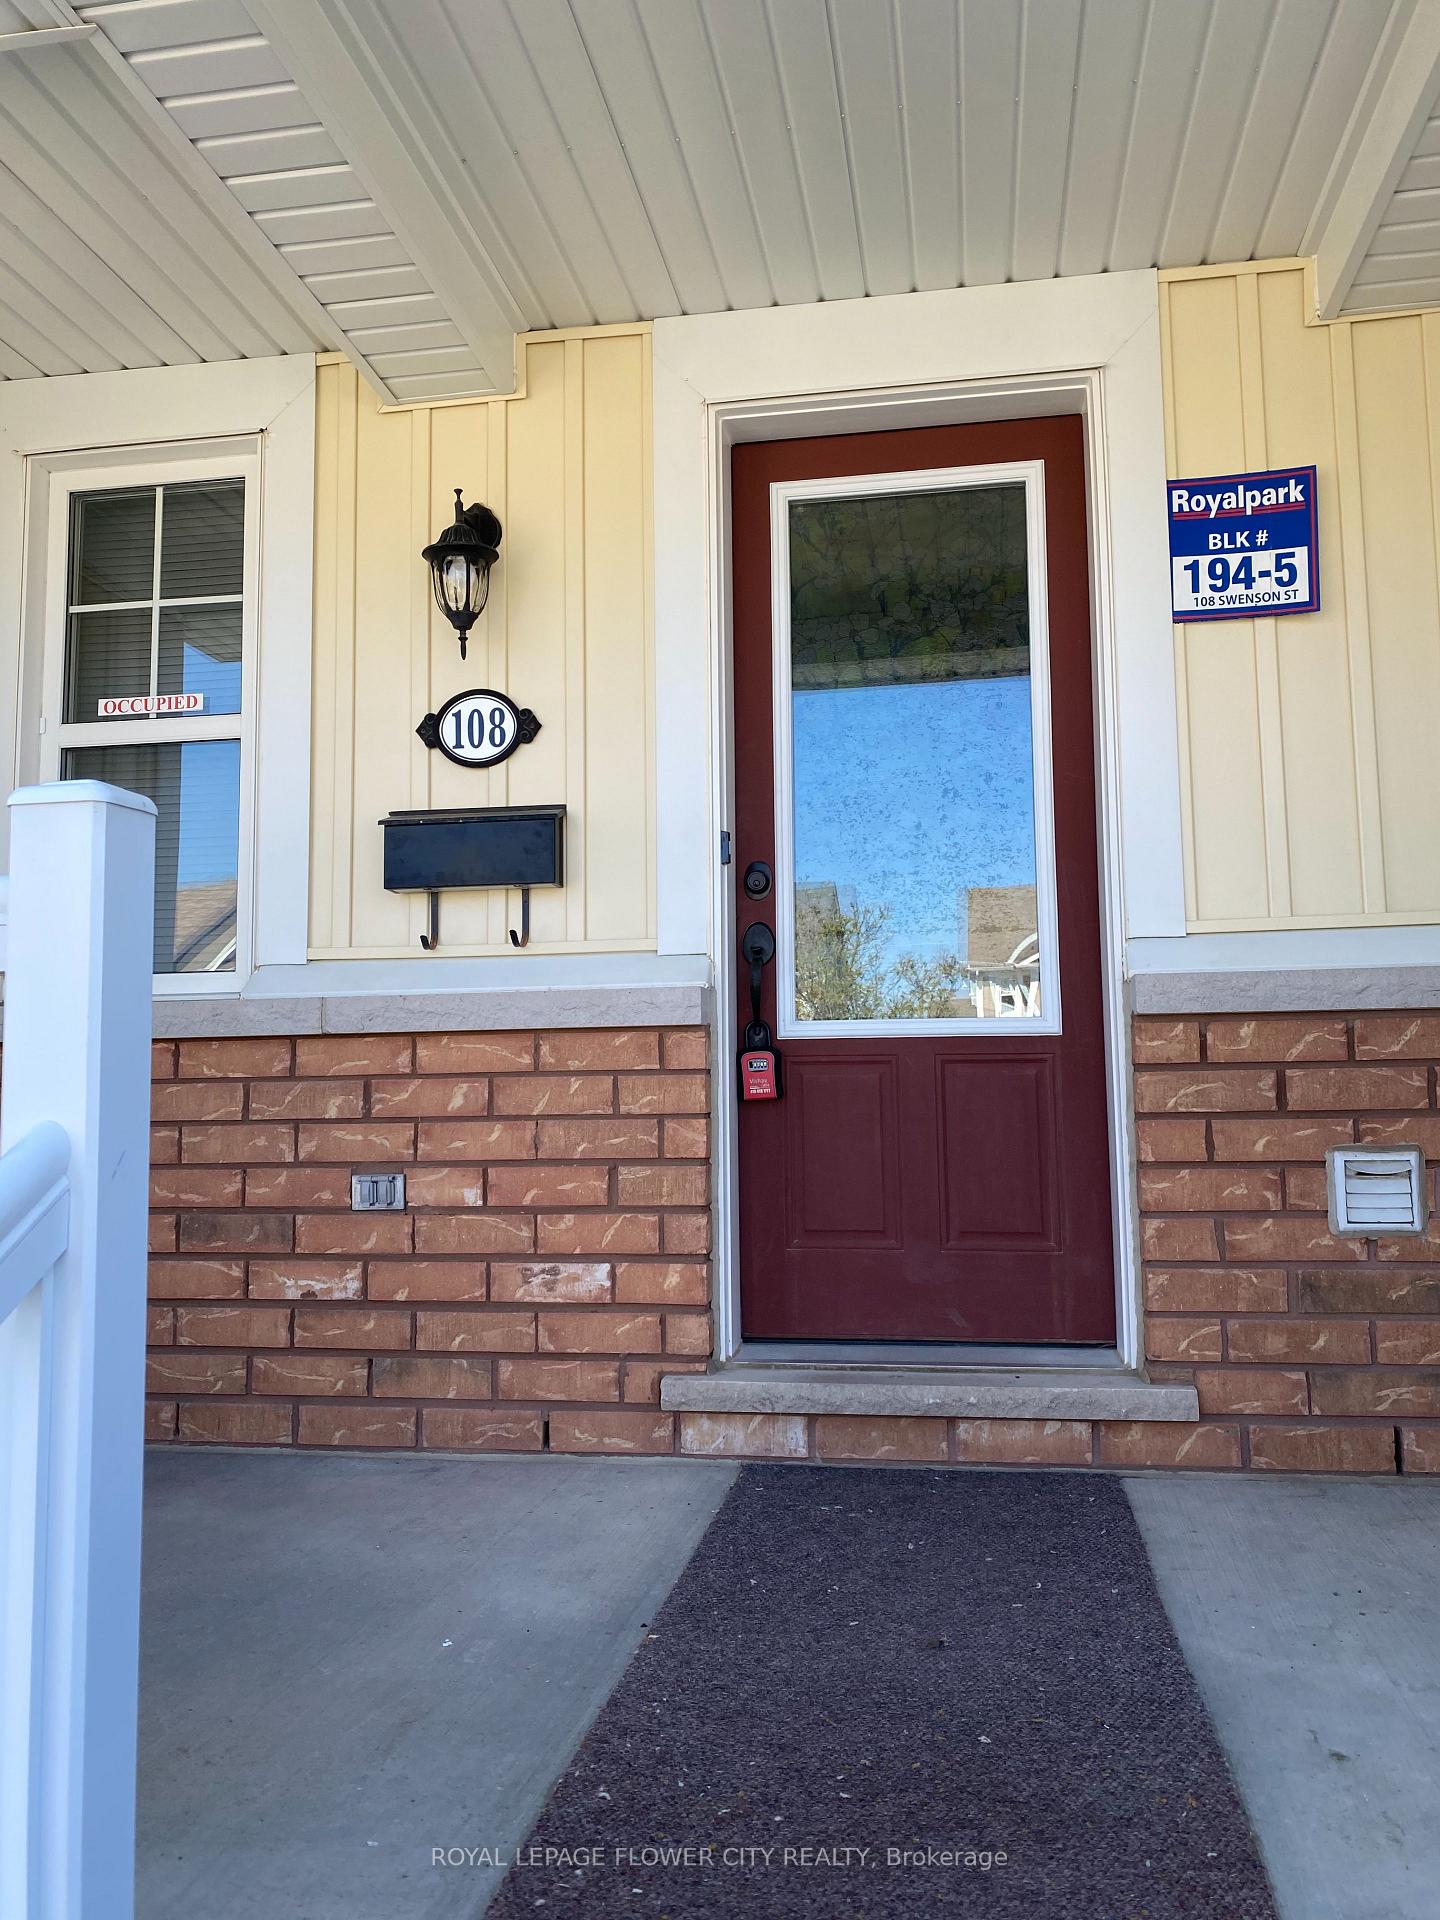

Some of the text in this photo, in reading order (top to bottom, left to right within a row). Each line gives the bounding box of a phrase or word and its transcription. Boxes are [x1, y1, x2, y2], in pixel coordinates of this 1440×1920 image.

[1172, 479, 1305, 518] Royalpark
[1208, 529, 1269, 550] BLK #
[1183, 551, 1298, 594] 194-5
[1194, 589, 1299, 607] 108 SWENSON ST
[103, 695, 198, 714] OCCUPIED
[451, 707, 506, 750] 108
